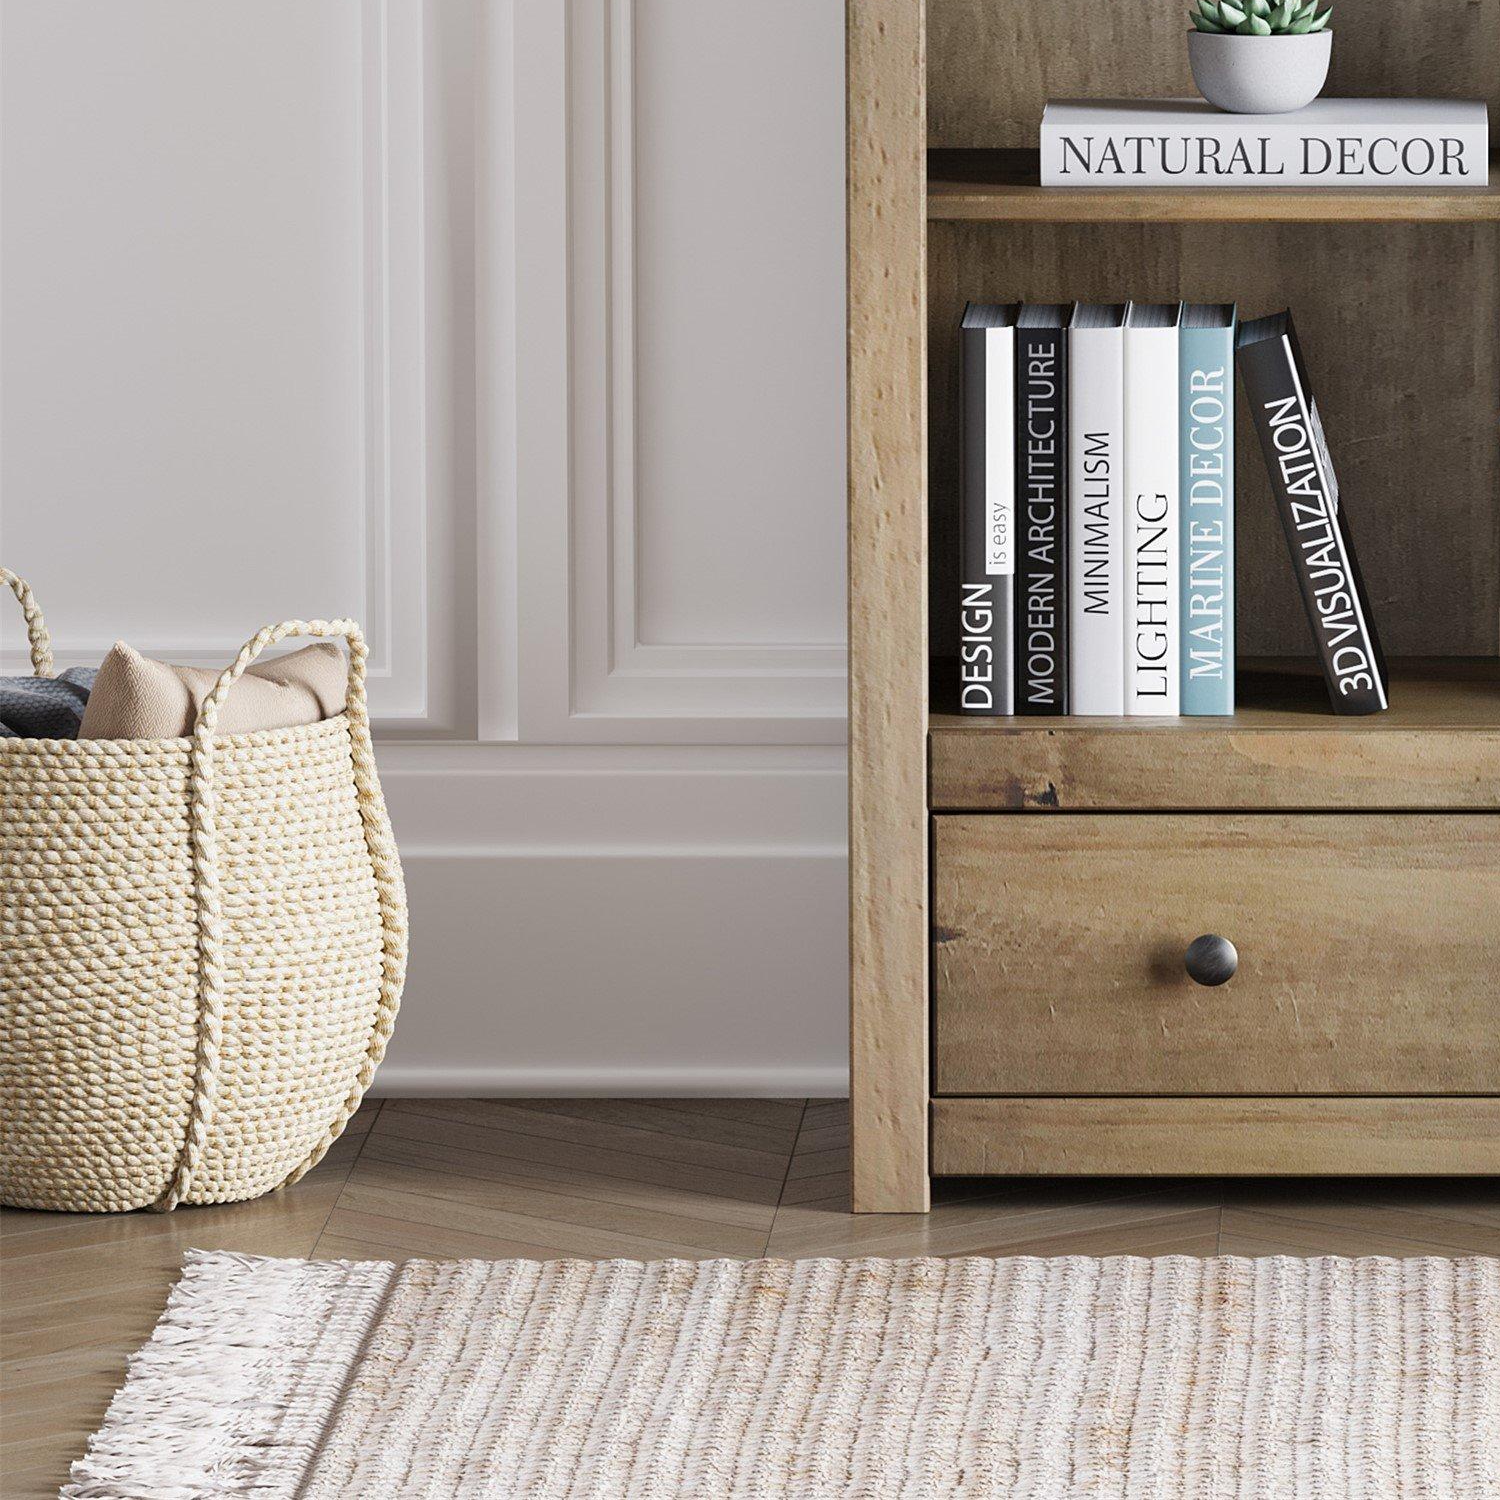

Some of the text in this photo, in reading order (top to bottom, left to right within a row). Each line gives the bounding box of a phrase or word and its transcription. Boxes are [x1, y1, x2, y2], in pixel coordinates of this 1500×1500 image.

[1059, 136, 1470, 176] NATURAL DECOR
[988, 502, 1012, 565] is easy
[1026, 342, 1055, 704] MODERN ARCHITECTURE
[1083, 432, 1110, 615] MINIMALISM
[1136, 493, 1168, 699] LIGHTING
[1189, 365, 1225, 680] MARINE DECOR
[1264, 395, 1374, 697] 3D VISUALIZATION
[961, 583, 993, 709] DESIGN
